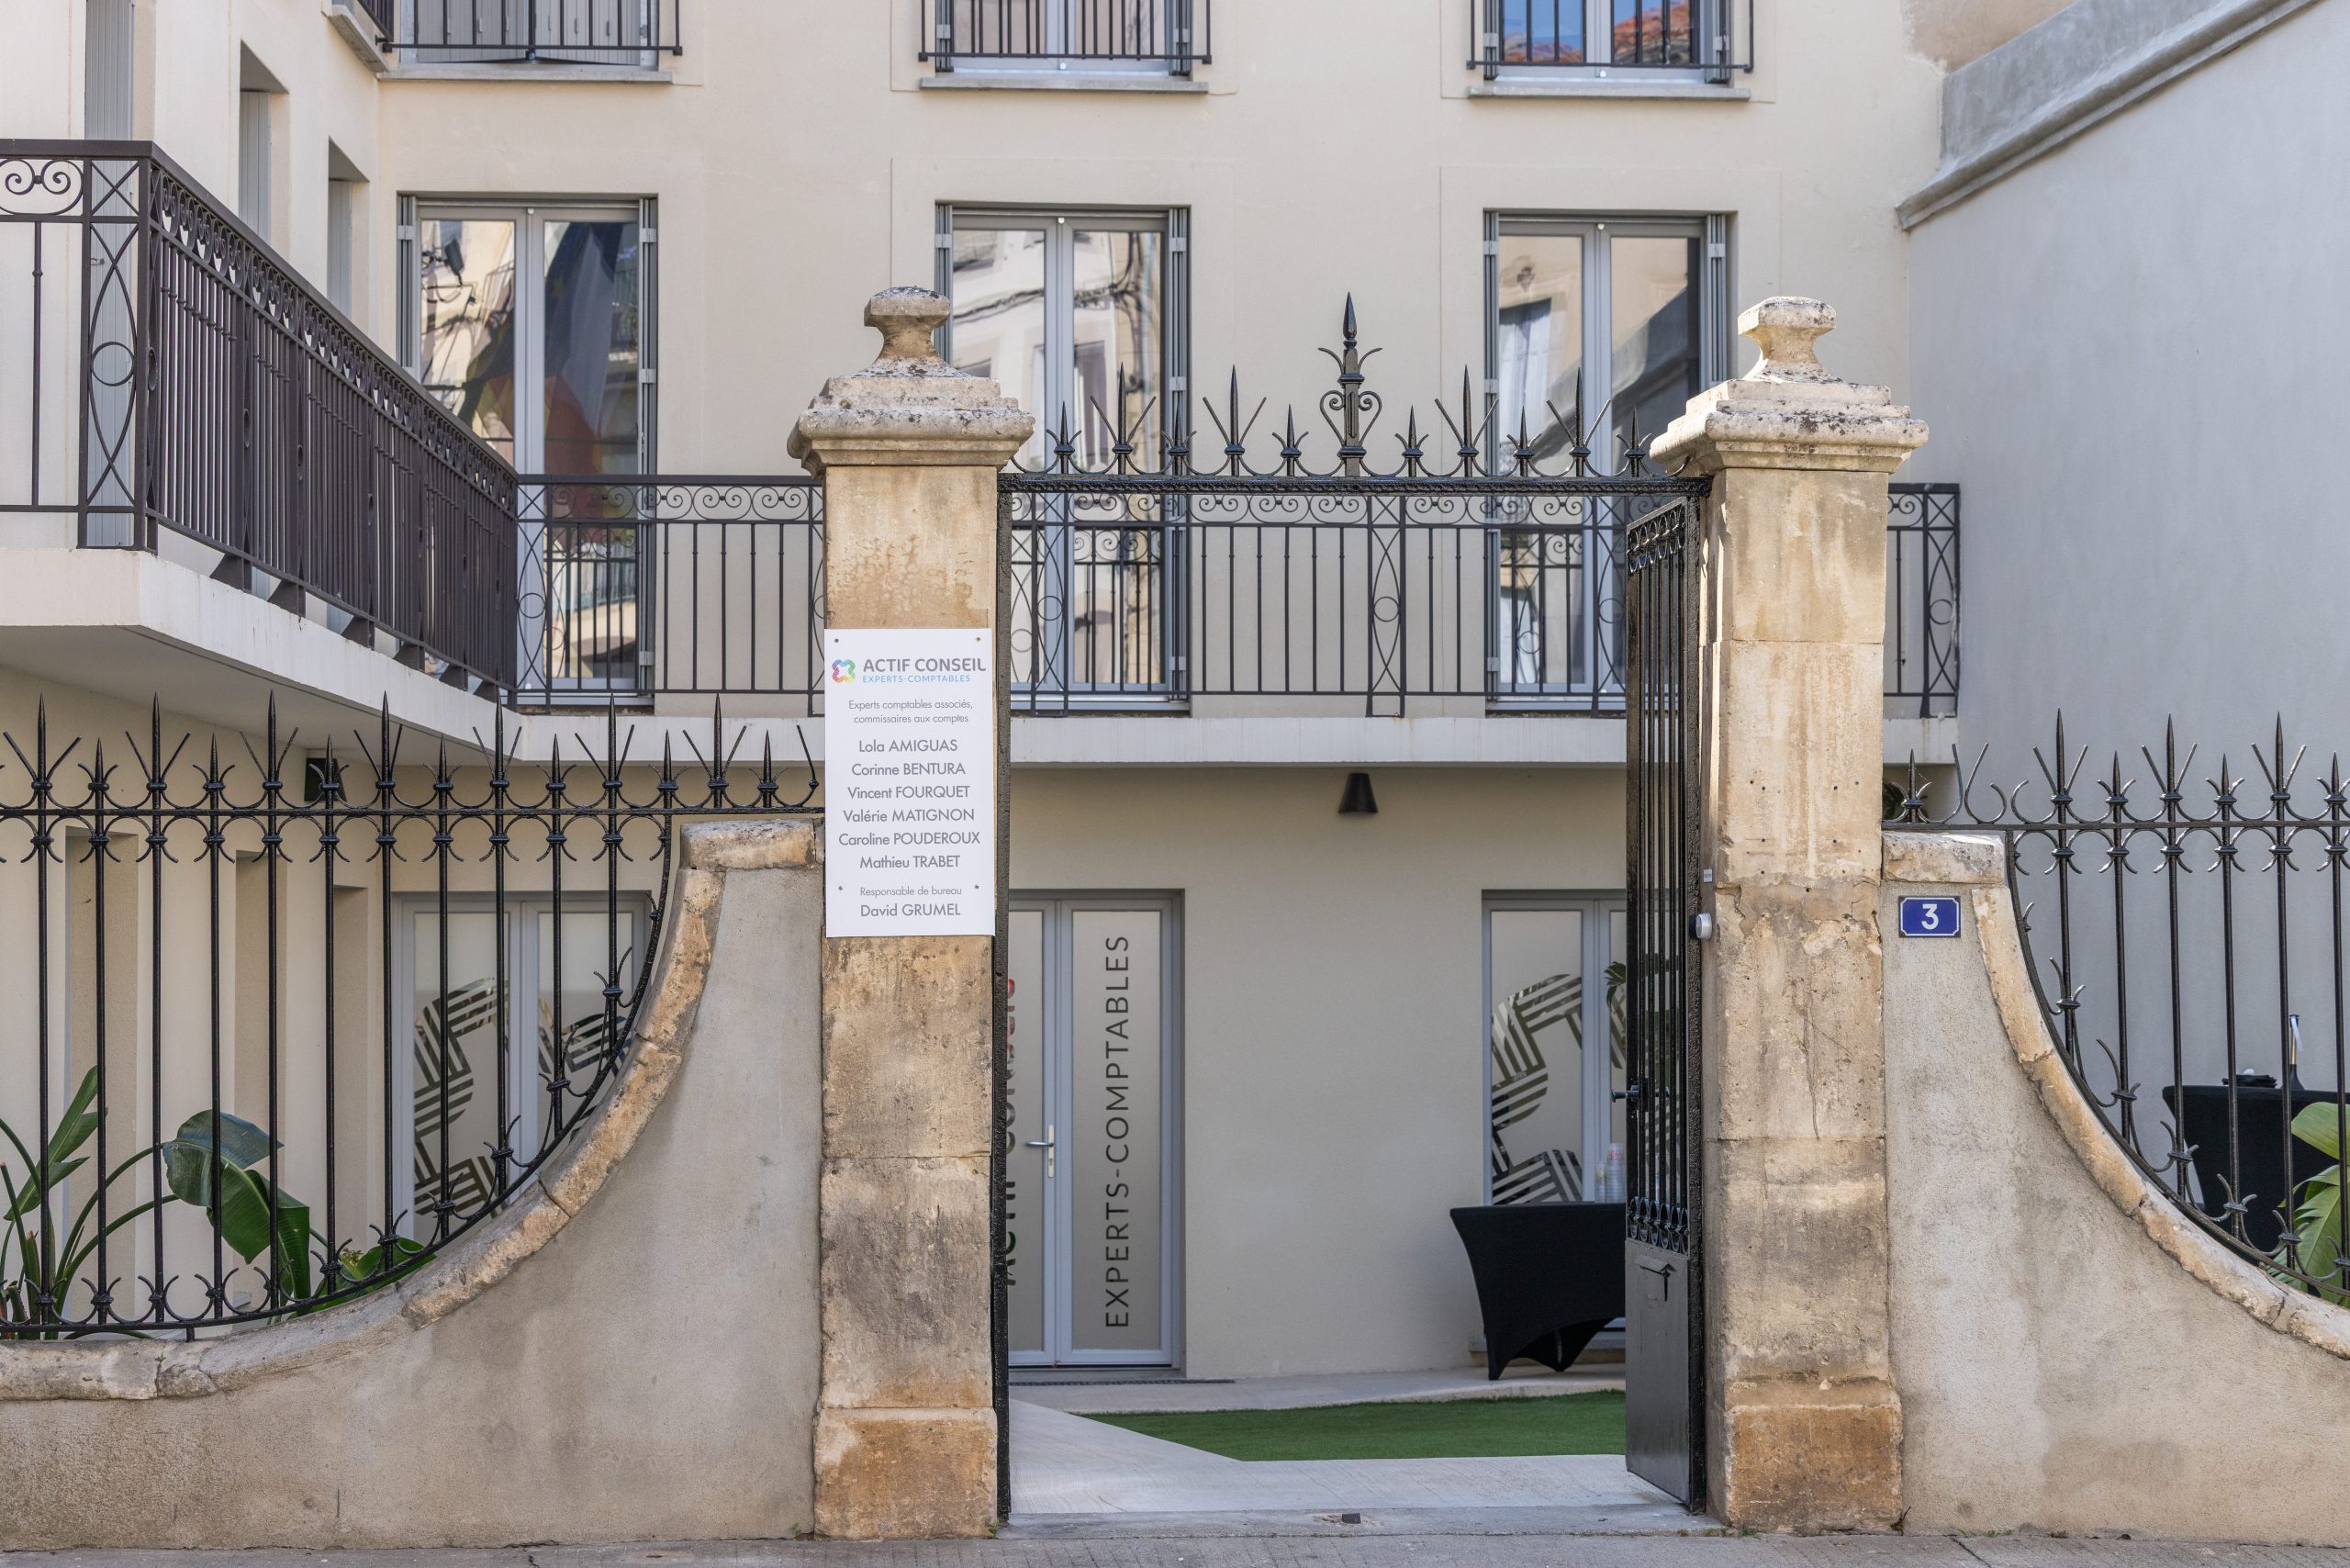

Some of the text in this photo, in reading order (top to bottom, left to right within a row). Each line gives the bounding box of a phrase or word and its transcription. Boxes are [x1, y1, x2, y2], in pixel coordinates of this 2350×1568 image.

[862, 657, 987, 672] ACTIF CONSEIL
[862, 674, 971, 683] EXPERTS-COMPTABLES
[847, 699, 973, 712] Experts comptables associés,
[853, 713, 969, 725] commissaires aux comptes
[858, 738, 958, 753] Lola AMIGUAS
[851, 762, 967, 777] Corinne BENTURA
[846, 785, 971, 800] Vincent FOURQUET
[842, 808, 975, 823] Valérie MATIGNON
[838, 831, 980, 846] Caroline POUDEROUX
[859, 855, 961, 868] Mathieu TRABET
[859, 885, 962, 899] Responsable de bureau
[860, 903, 961, 917] David GRUMEL
[1920, 903, 1939, 930] 3
[1105, 935, 1129, 1327] EXPERTS-COMPTABLES
